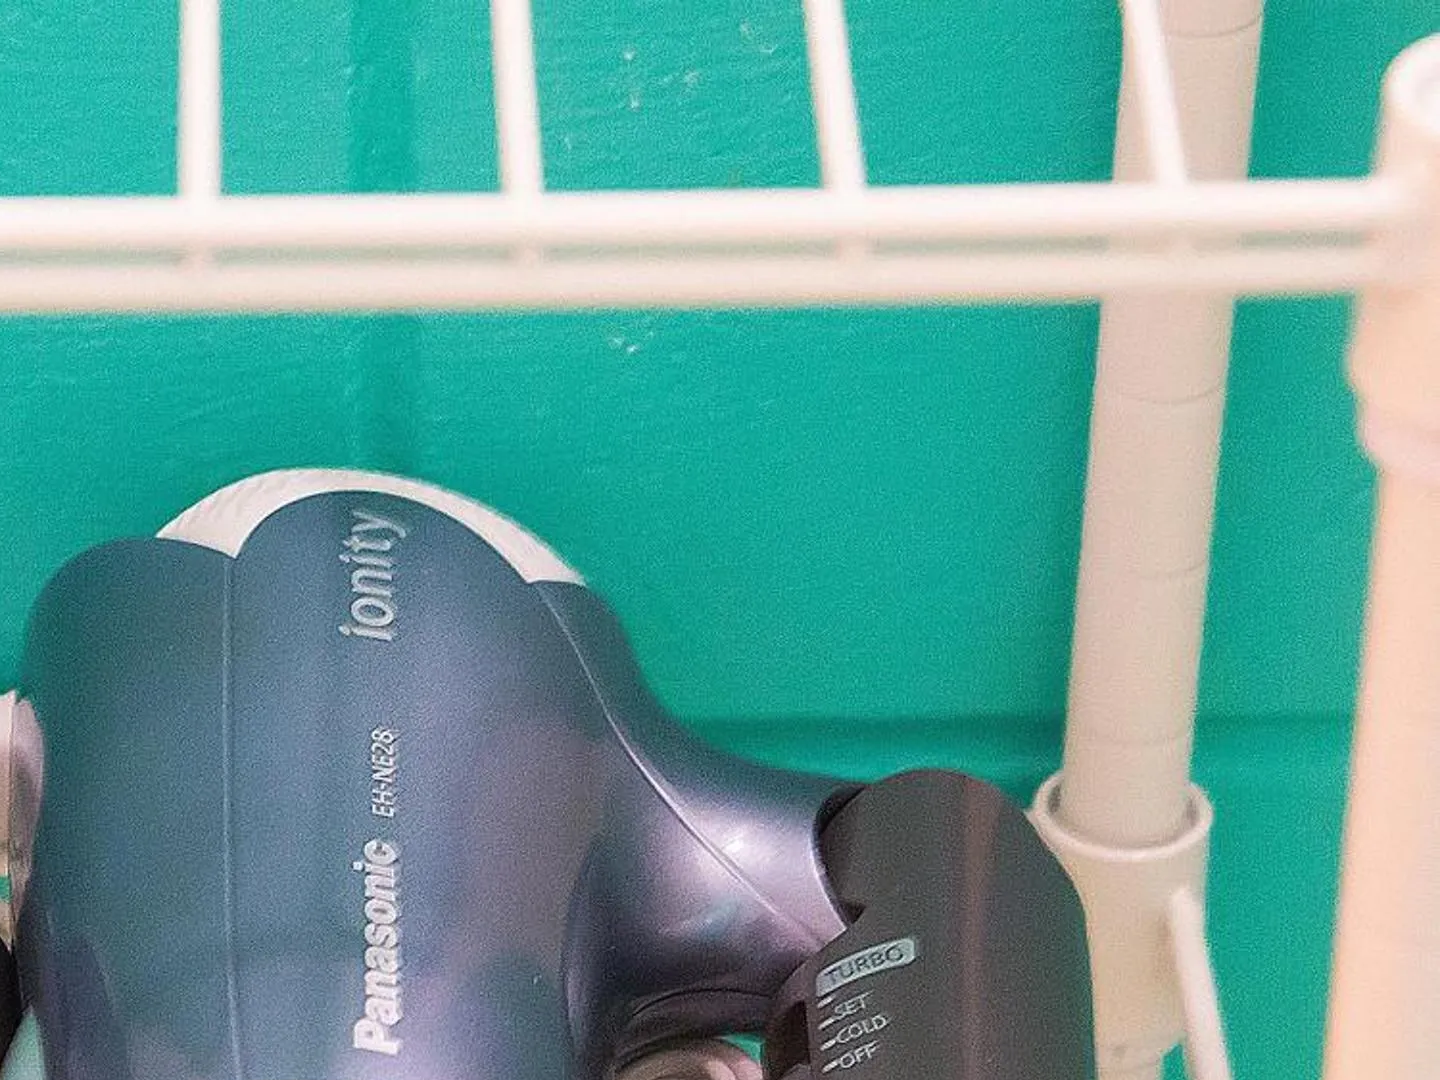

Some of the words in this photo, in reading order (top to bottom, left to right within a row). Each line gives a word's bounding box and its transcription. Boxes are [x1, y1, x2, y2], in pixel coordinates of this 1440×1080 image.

[339, 511, 407, 643] ionity
[371, 727, 398, 820] EH-NE28
[351, 838, 401, 1057] Panasonic
[824, 944, 904, 984] TURBO
[835, 991, 872, 1018] SET
[836, 1014, 891, 1044] COLD
[839, 1039, 881, 1069] OFF
